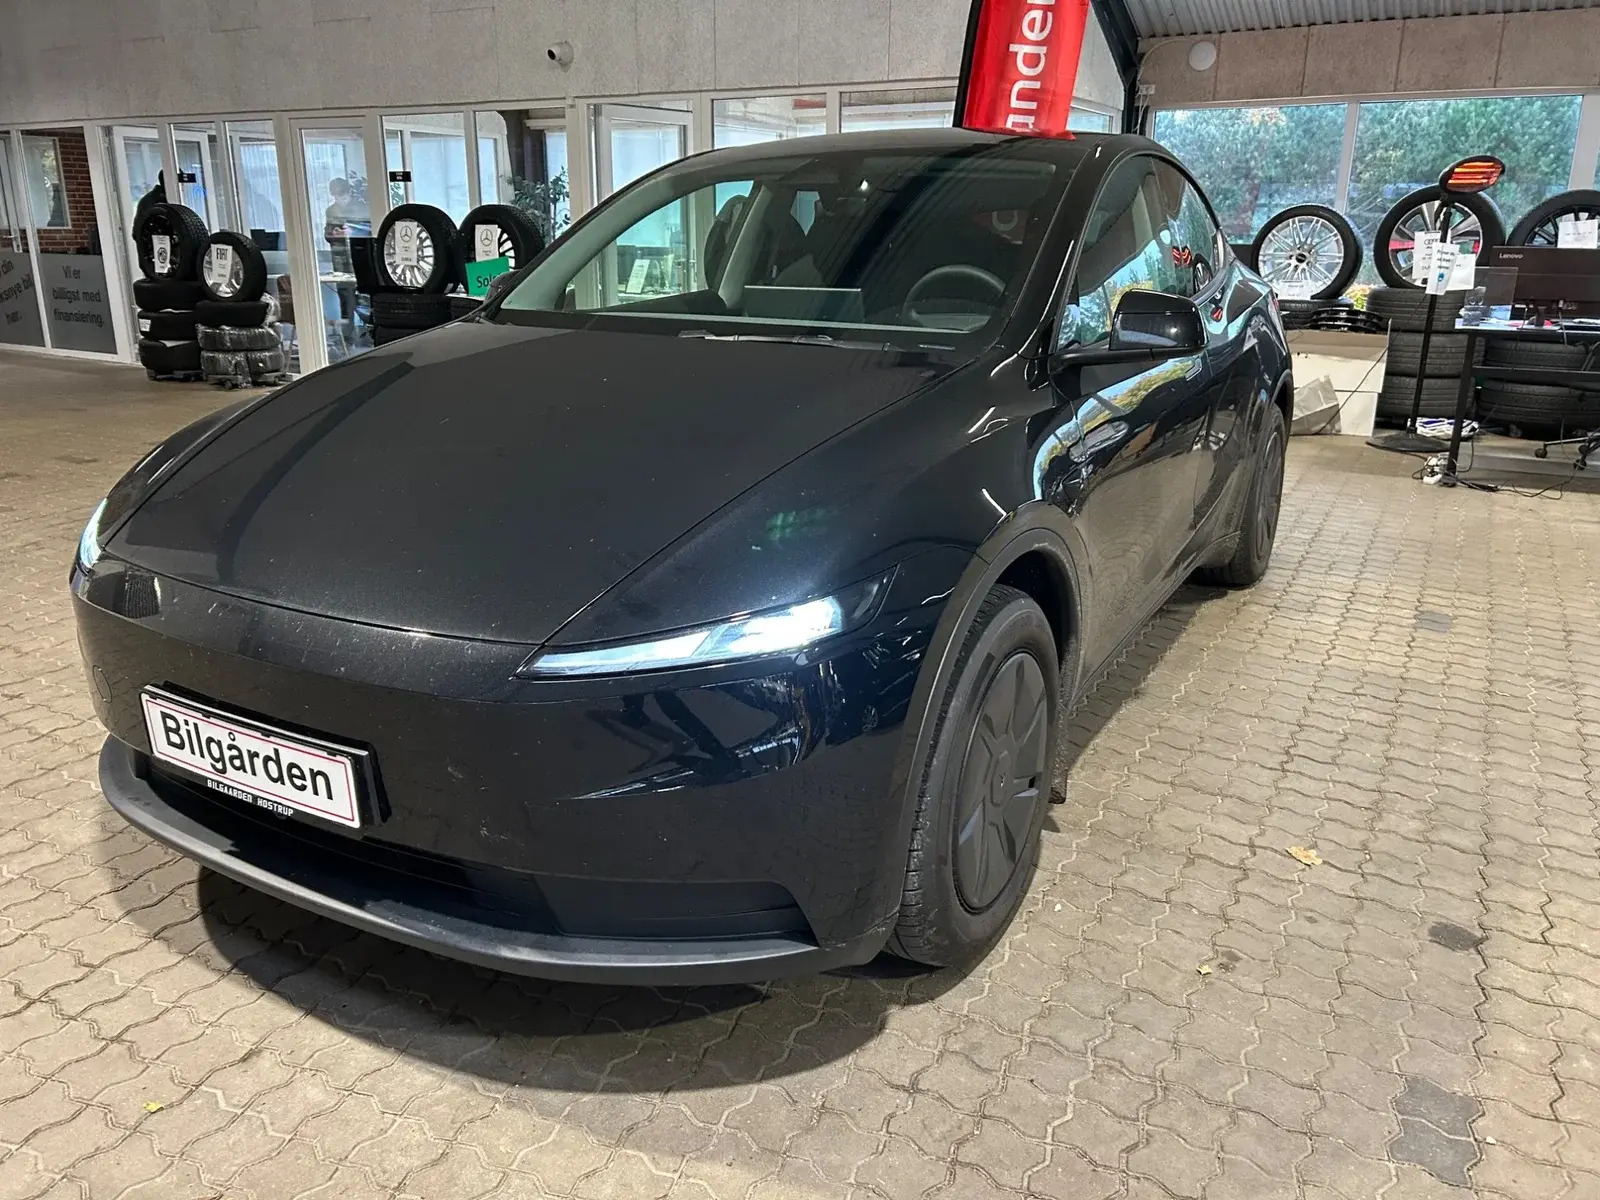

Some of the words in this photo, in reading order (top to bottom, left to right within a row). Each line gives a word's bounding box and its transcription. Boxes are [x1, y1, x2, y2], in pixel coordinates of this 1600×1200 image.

[61, 265, 71, 279] Vi
[72, 268, 81, 279] er
[476, 273, 496, 288] Sol
[21, 273, 34, 290] bil
[82, 289, 102, 302] med
[53, 308, 105, 328] finansiering.
[160, 710, 334, 801] Bilgården
[207, 779, 253, 804] BILGAARDEN
[257, 797, 294, 817] HOSTRUP
